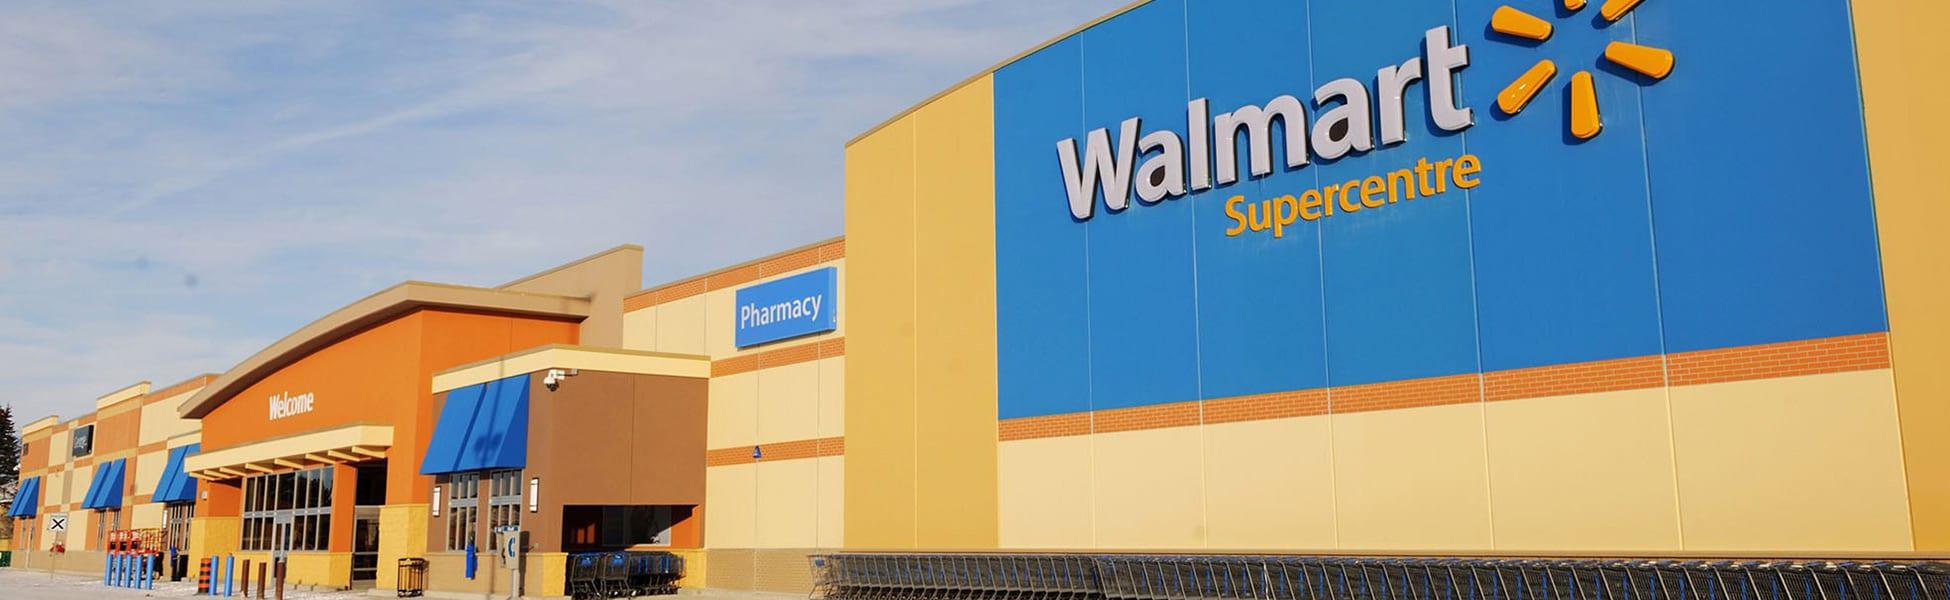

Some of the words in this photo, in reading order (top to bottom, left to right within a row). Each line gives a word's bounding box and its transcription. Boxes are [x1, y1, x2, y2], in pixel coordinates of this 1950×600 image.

[1057, 26, 1474, 219] Walmart
[1225, 155, 1480, 237] Supercentre
[741, 294, 822, 329] Pharmacy
[269, 391, 314, 420] Welcome
